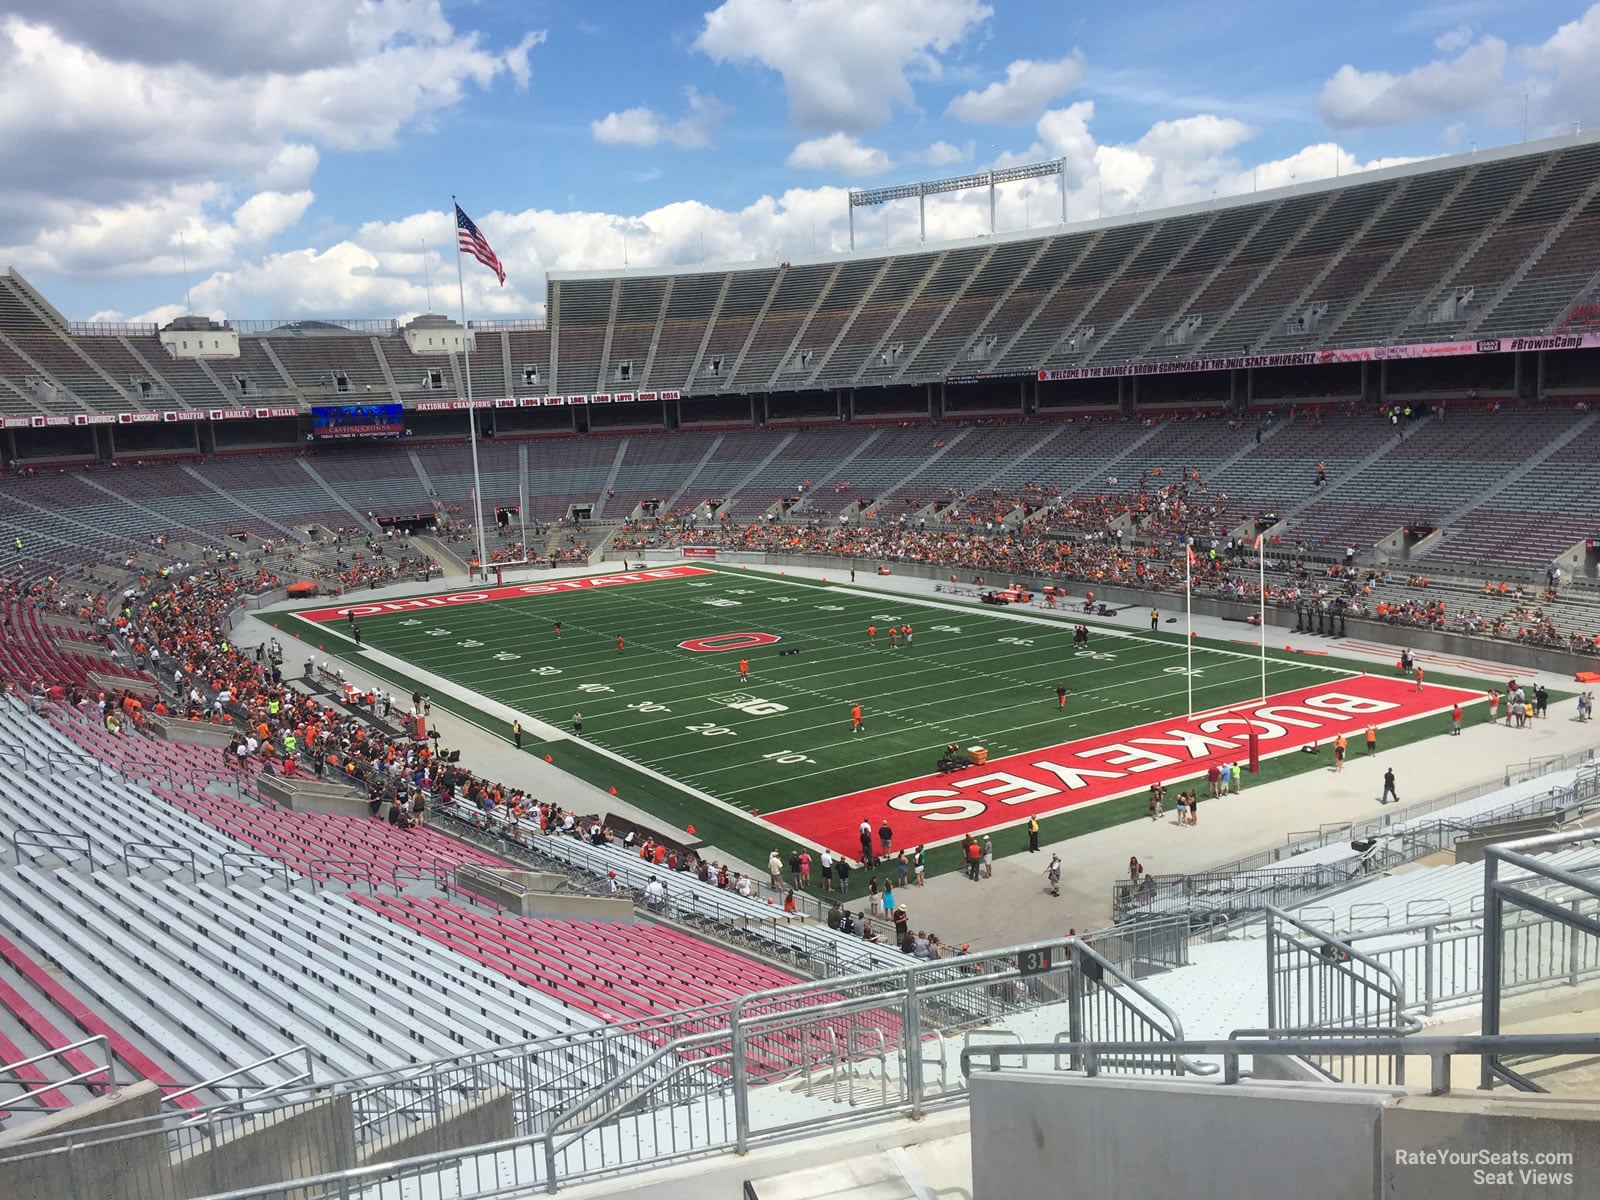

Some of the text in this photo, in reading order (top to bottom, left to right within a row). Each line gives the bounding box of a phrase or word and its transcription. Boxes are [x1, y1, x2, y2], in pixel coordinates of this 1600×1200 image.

[1511, 337, 1582, 350] #BrownsCamp
[1051, 369, 1079, 379] WELCOME
[1081, 369, 1088, 377] TO
[1090, 367, 1102, 377] THE
[1102, 366, 1127, 376] ORANGE
[1134, 364, 1158, 374] BROWN
[1159, 361, 1199, 372] SCRIMMAGE
[1200, 360, 1209, 370] AT
[1211, 359, 1224, 369] THE
[1226, 358, 1244, 368] OHIO
[1245, 356, 1268, 367] STATE
[1269, 353, 1316, 366] UNIVERSITY
[418, 400, 491, 410] NATIONAL CHAMPIONS
[271, 409, 295, 417] WILLIS
[337, 568, 685, 616] OHIO STATE
[530, 666, 563, 676] 50
[577, 683, 612, 693] 40
[627, 701, 666, 713] 30
[685, 723, 731, 736] 20
[762, 750, 807, 764] 10
[887, 692, 1402, 821] BUCKEYES
[1027, 951, 1045, 970] 31
